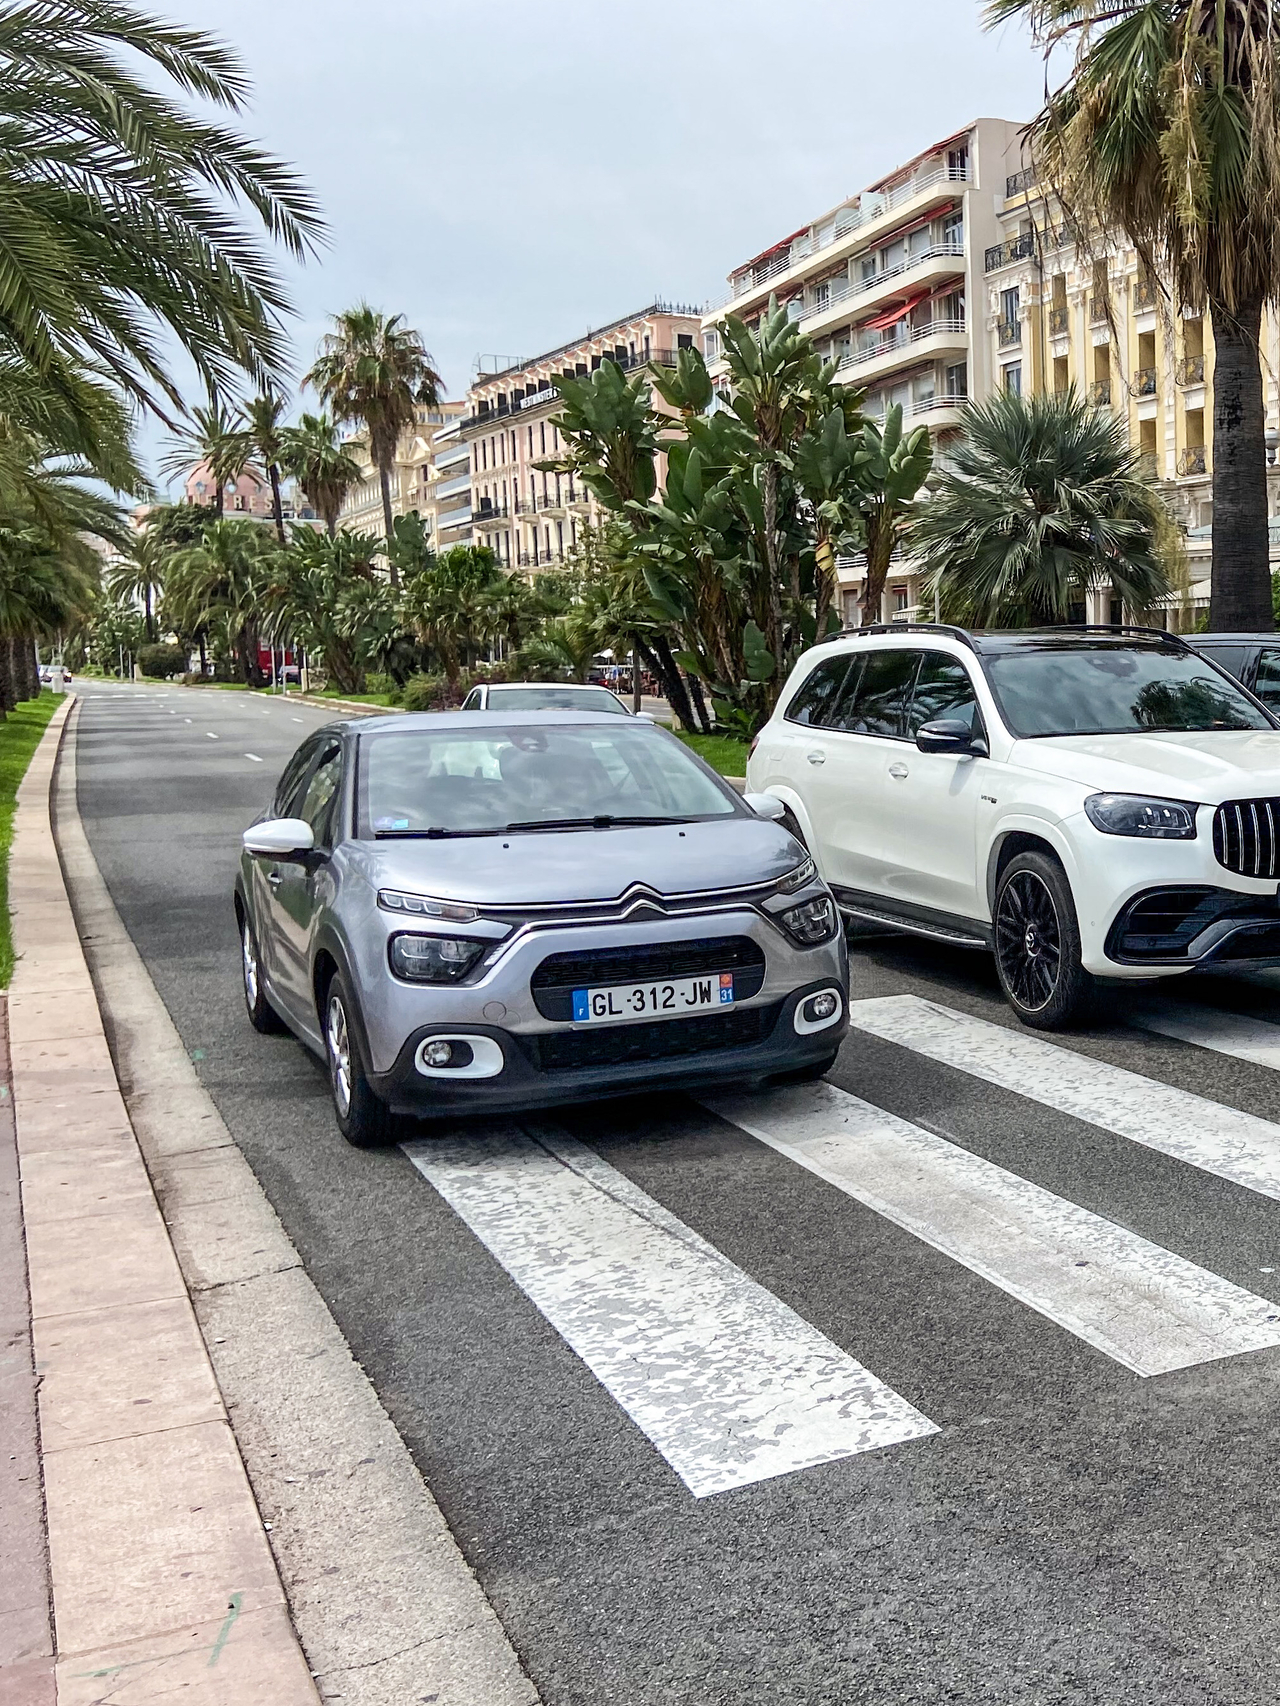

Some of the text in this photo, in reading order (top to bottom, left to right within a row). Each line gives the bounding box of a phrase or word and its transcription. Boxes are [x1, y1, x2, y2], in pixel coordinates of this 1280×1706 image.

[192, 494, 303, 511] NERESO
[591, 980, 712, 1017] GL-312-JW
[720, 988, 733, 1001] 31
[578, 1008, 584, 1017] F
